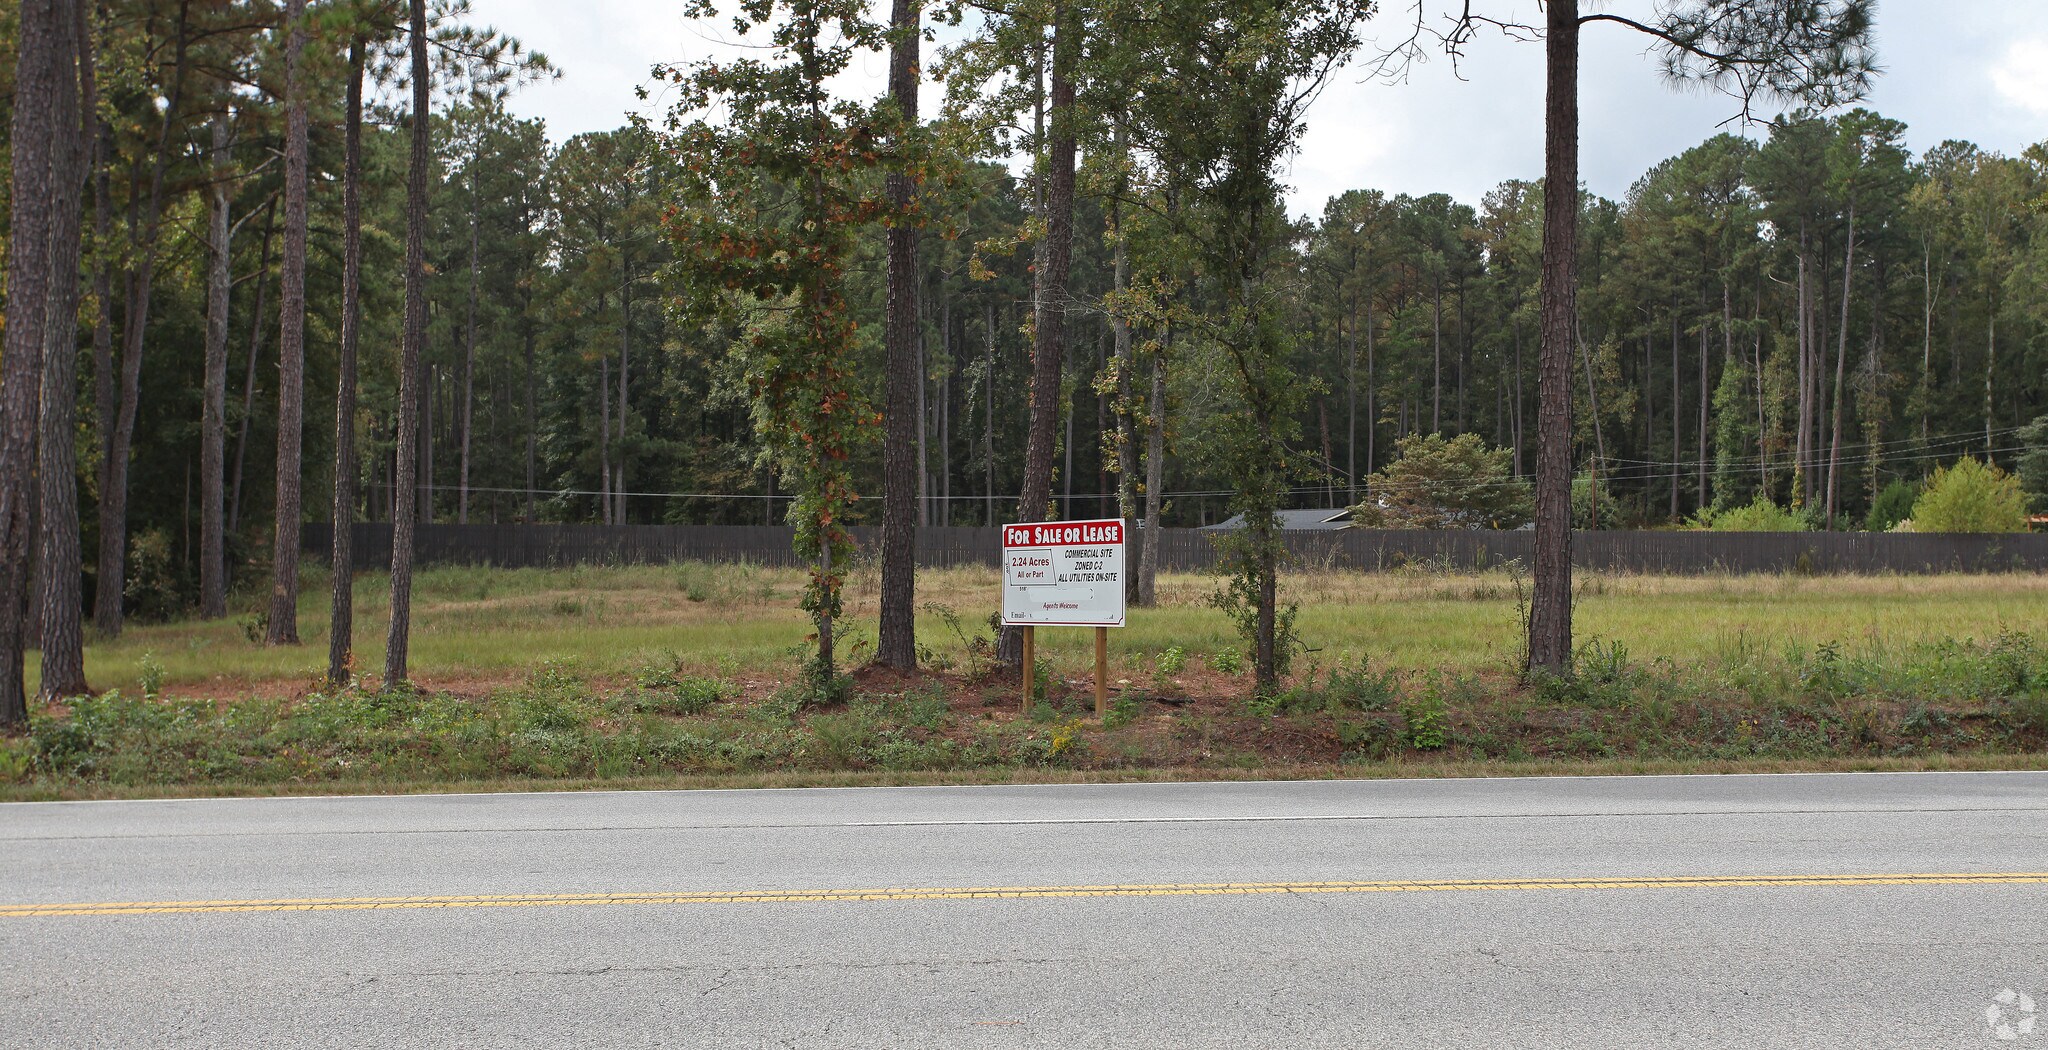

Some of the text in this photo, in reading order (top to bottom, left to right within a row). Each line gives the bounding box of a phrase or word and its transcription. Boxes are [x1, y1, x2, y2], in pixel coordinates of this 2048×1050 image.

[1008, 524, 1118, 545] FOR SALE OR LEASE
[1064, 548, 1113, 558] COMMERCIAL SITE
[1012, 556, 1050, 567] 2.24 Acres
[1074, 560, 1103, 570] ZONED C-2
[1017, 570, 1025, 579] All
[1032, 570, 1044, 578] Part
[1058, 572, 1118, 582] ALL UTILITIES ON-SITE
[1042, 602, 1059, 611] Agents
